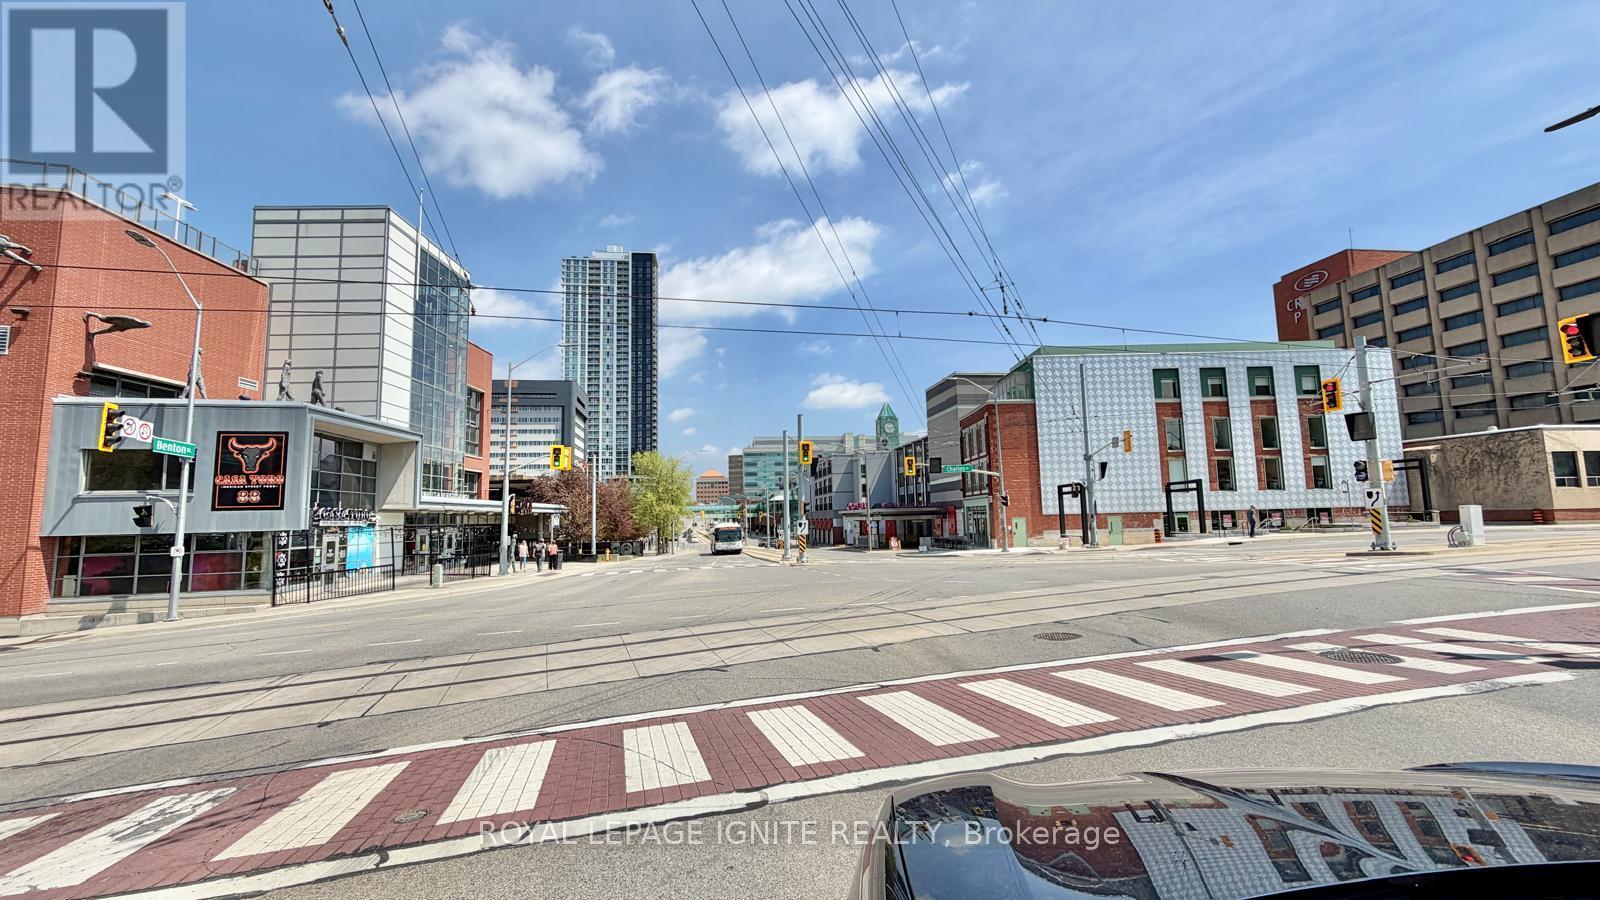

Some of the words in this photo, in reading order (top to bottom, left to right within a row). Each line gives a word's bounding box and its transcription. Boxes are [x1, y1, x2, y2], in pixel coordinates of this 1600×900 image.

[156, 440, 187, 454] Benton
[215, 475, 247, 485] CASA
[249, 475, 284, 485] TORO
